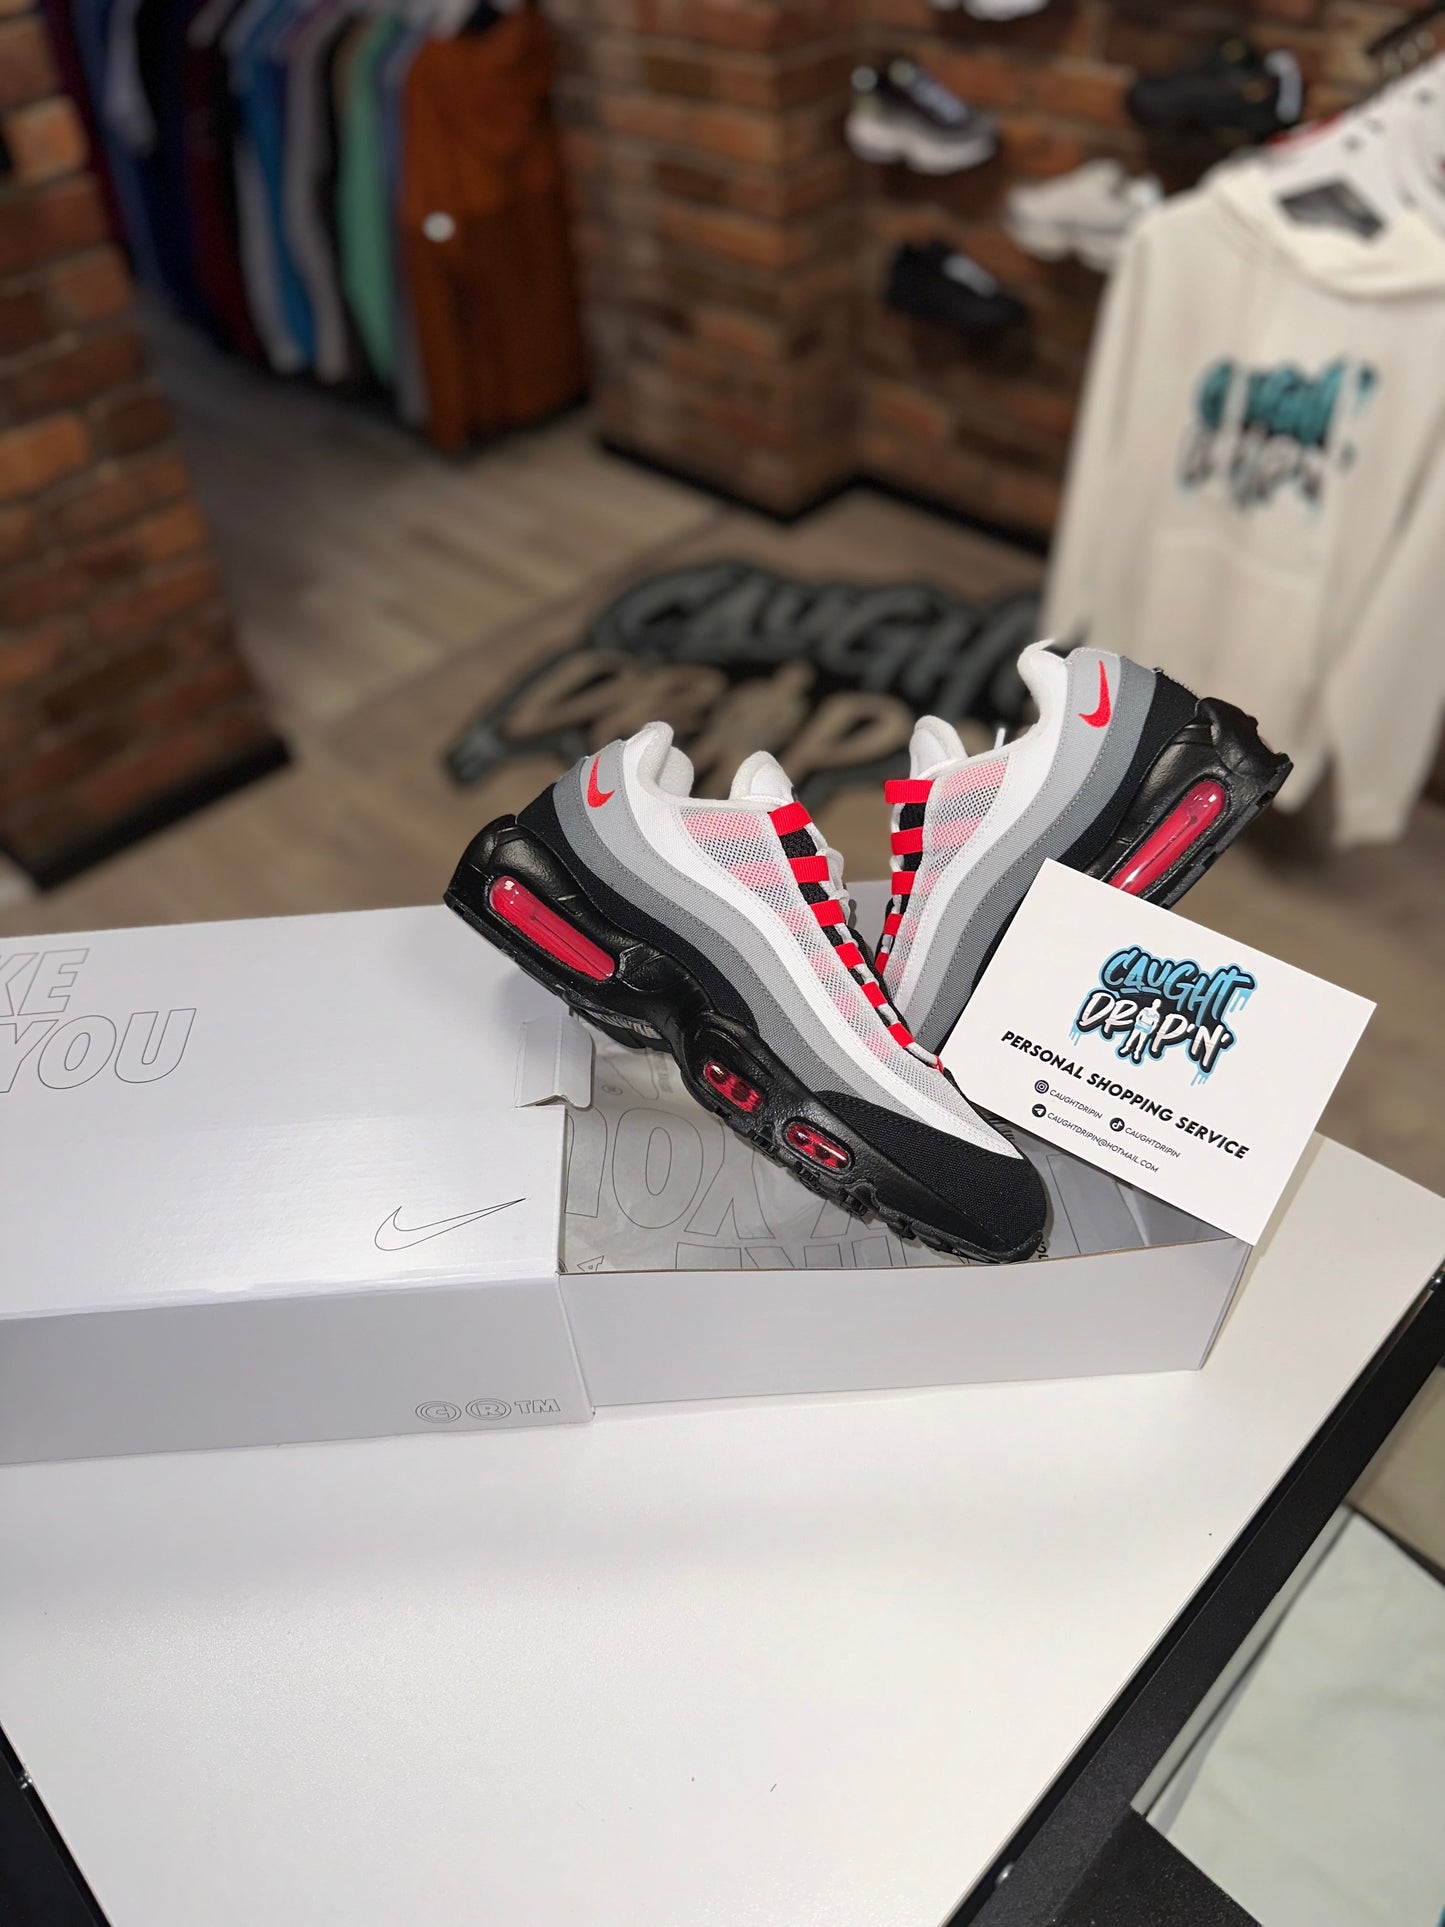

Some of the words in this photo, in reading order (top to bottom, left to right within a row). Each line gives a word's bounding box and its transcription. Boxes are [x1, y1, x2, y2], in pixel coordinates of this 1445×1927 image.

[1101, 946, 1255, 1028] CAUGHT
[0, 1007, 197, 1093] YOU
[1000, 1030, 1082, 1080] PERSONAL
[1087, 1072, 1174, 1122] SHOPPING
[1175, 1116, 1250, 1160] SERVICE
[1049, 1089, 1103, 1119] CAUGHTDRIPIN
[1047, 1112, 1160, 1173] CAUGHTDRIPIN@HOTMAIL.COM
[1125, 1127, 1181, 1158] CAUGHTDRIPIN
